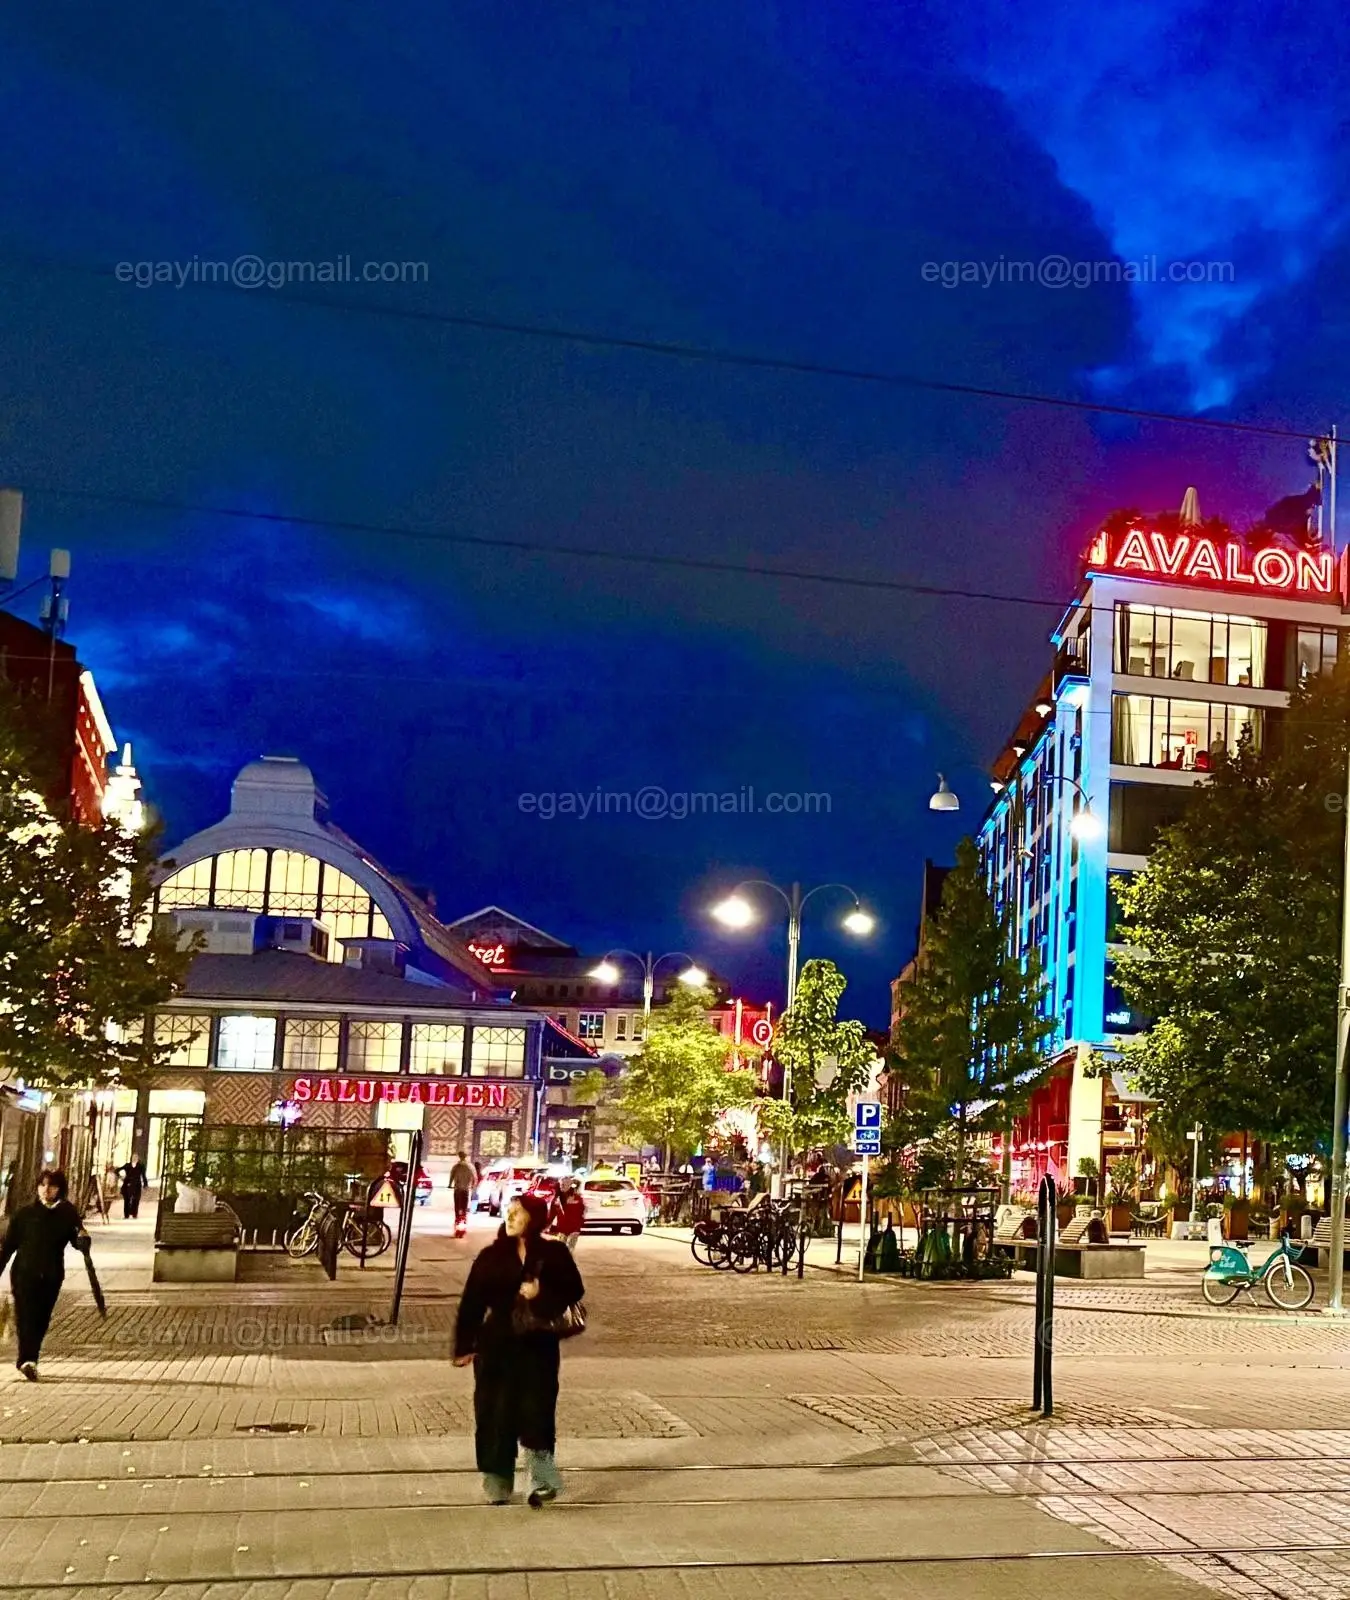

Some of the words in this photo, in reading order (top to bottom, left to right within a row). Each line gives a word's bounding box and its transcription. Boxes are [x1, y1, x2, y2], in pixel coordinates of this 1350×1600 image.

[1113, 529, 1334, 593] AVALON
[293, 1078, 508, 1107] SALUHALLEN
[862, 1105, 876, 1125] P
